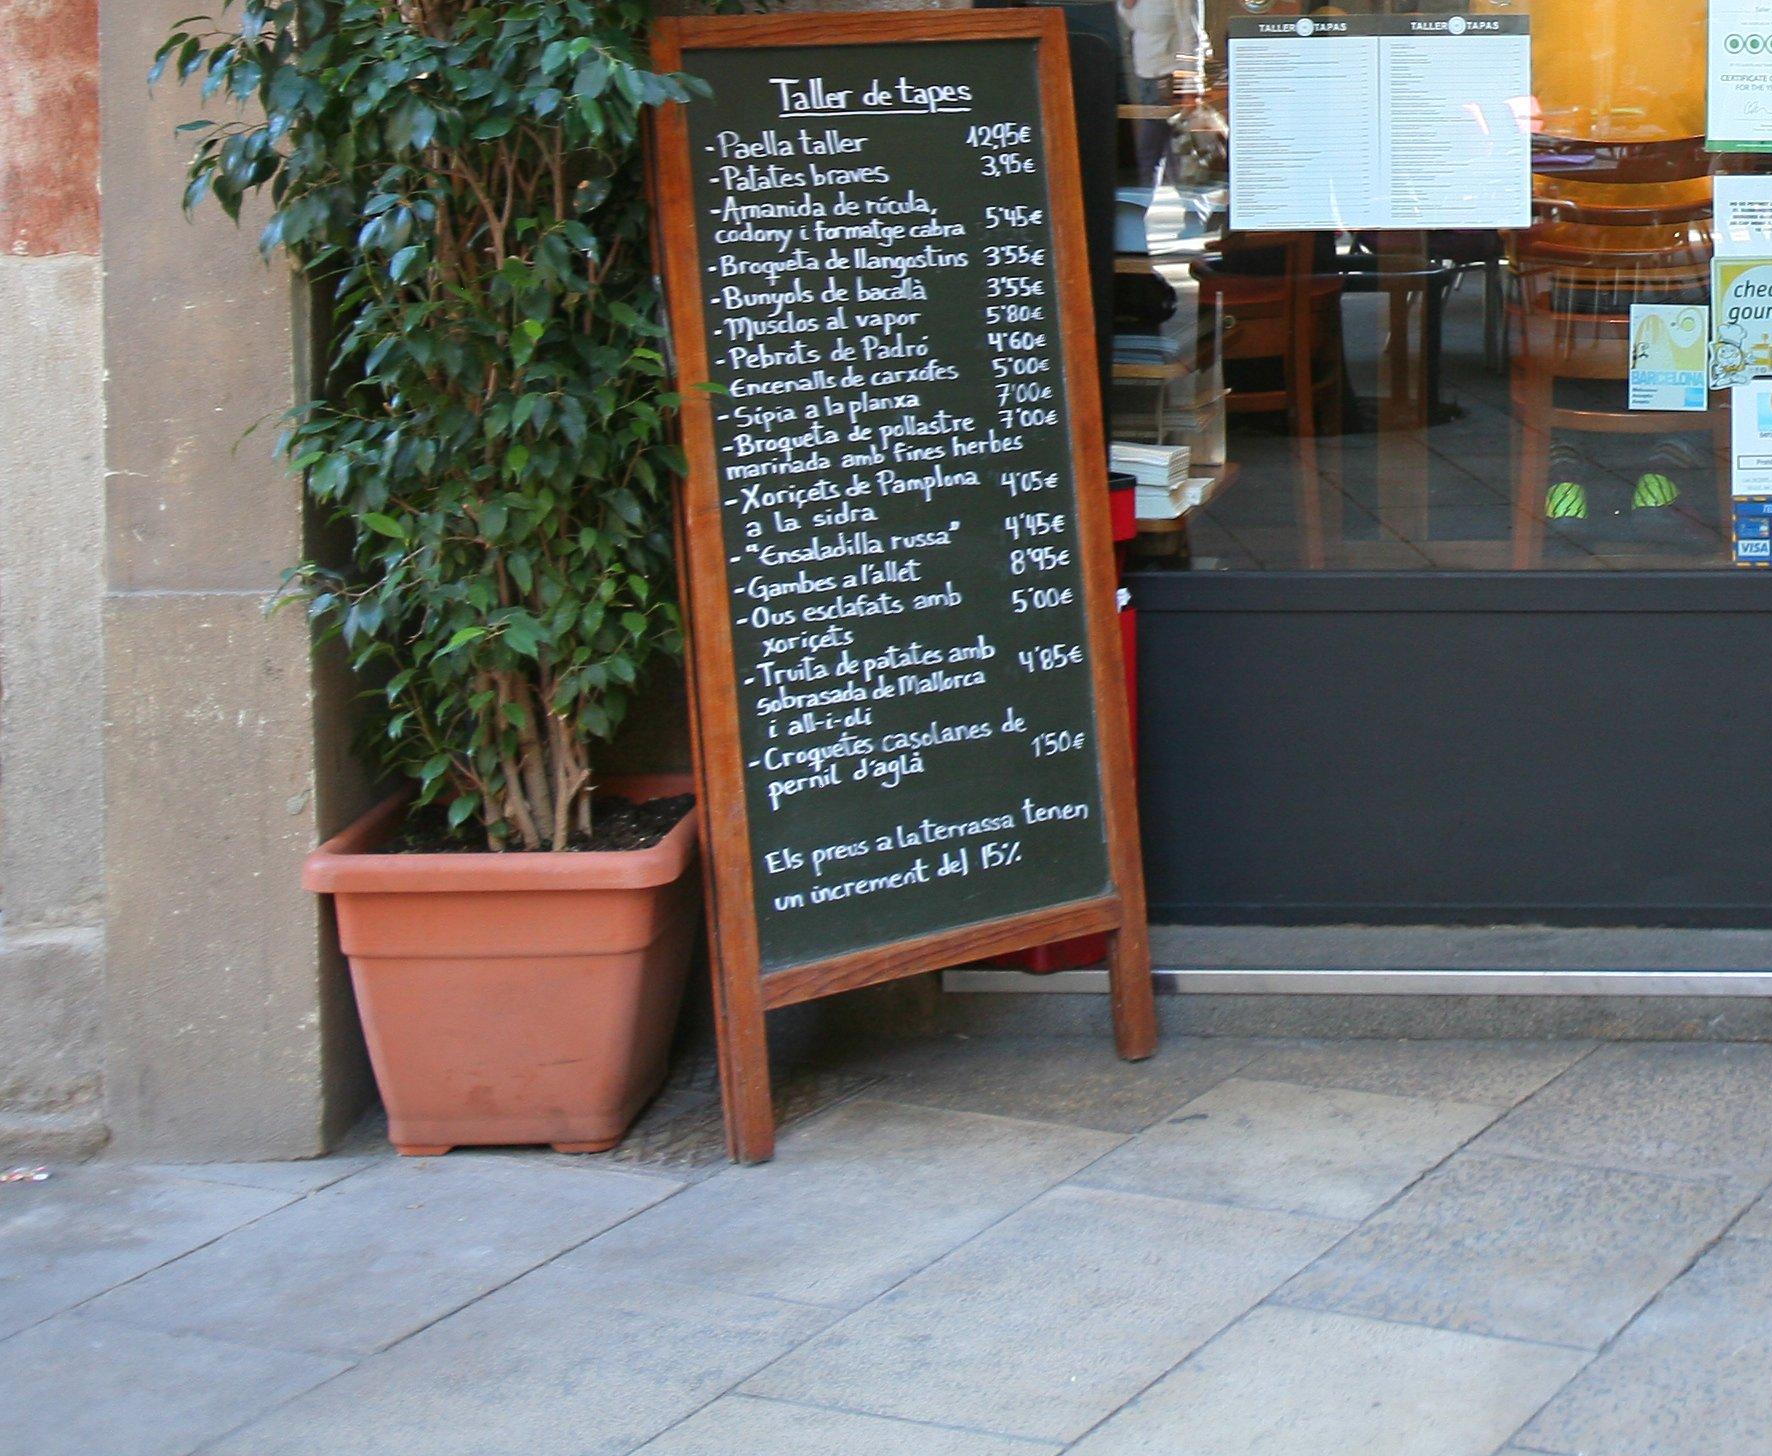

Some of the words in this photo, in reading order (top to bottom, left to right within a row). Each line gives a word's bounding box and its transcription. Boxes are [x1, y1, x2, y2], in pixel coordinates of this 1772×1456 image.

[1258, 23, 1296, 33] TALLER
[1314, 22, 1347, 33] TAPAS
[1411, 21, 1448, 31] TALLER
[1466, 20, 1499, 31] TAPAS
[767, 78, 853, 111] Taller
[861, 79, 893, 105] de
[894, 77, 973, 114] tapes
[797, 129, 869, 155] taller
[808, 164, 890, 186] braves
[832, 191, 860, 215] de
[713, 223, 793, 258] codony
[813, 219, 906, 251] formatge
[908, 218, 966, 237] cabra
[823, 248, 851, 269] de
[853, 245, 969, 282] llangostins
[820, 279, 849, 303] de
[825, 306, 849, 330] al
[854, 313, 921, 337] vapor
[829, 337, 857, 361] de
[839, 367, 865, 387] de
[823, 396, 845, 416] la
[847, 392, 921, 423] planxa
[846, 421, 872, 441] de
[878, 410, 976, 450] pollastre
[725, 452, 832, 480] marinada
[840, 443, 885, 468] amb
[892, 442, 946, 462] fines
[951, 427, 1023, 457] herbes
[844, 475, 872, 496] de
[874, 467, 981, 502] Pamplona
[773, 511, 801, 532] la
[811, 501, 879, 526] sidra
[1741, 543, 1769, 552] VISA
[801, 593, 905, 621] esclafats
[912, 581, 962, 610] amb
[834, 650, 860, 676] de
[862, 642, 944, 682] patates
[947, 635, 996, 663] amb
[871, 675, 895, 699] de
[897, 671, 986, 696] Mallorca
[880, 721, 993, 752] casolanes
[1000, 707, 1027, 732] de
[767, 764, 842, 811] pernil
[763, 848, 804, 873] Els
[810, 841, 870, 876] preus
[895, 825, 922, 848] la
[918, 815, 1015, 844] terrassa
[1020, 798, 1088, 824] tenen
[773, 894, 805, 910] un
[809, 858, 930, 903] increment
[936, 848, 968, 876] del
[980, 841, 1022, 869] 15%
